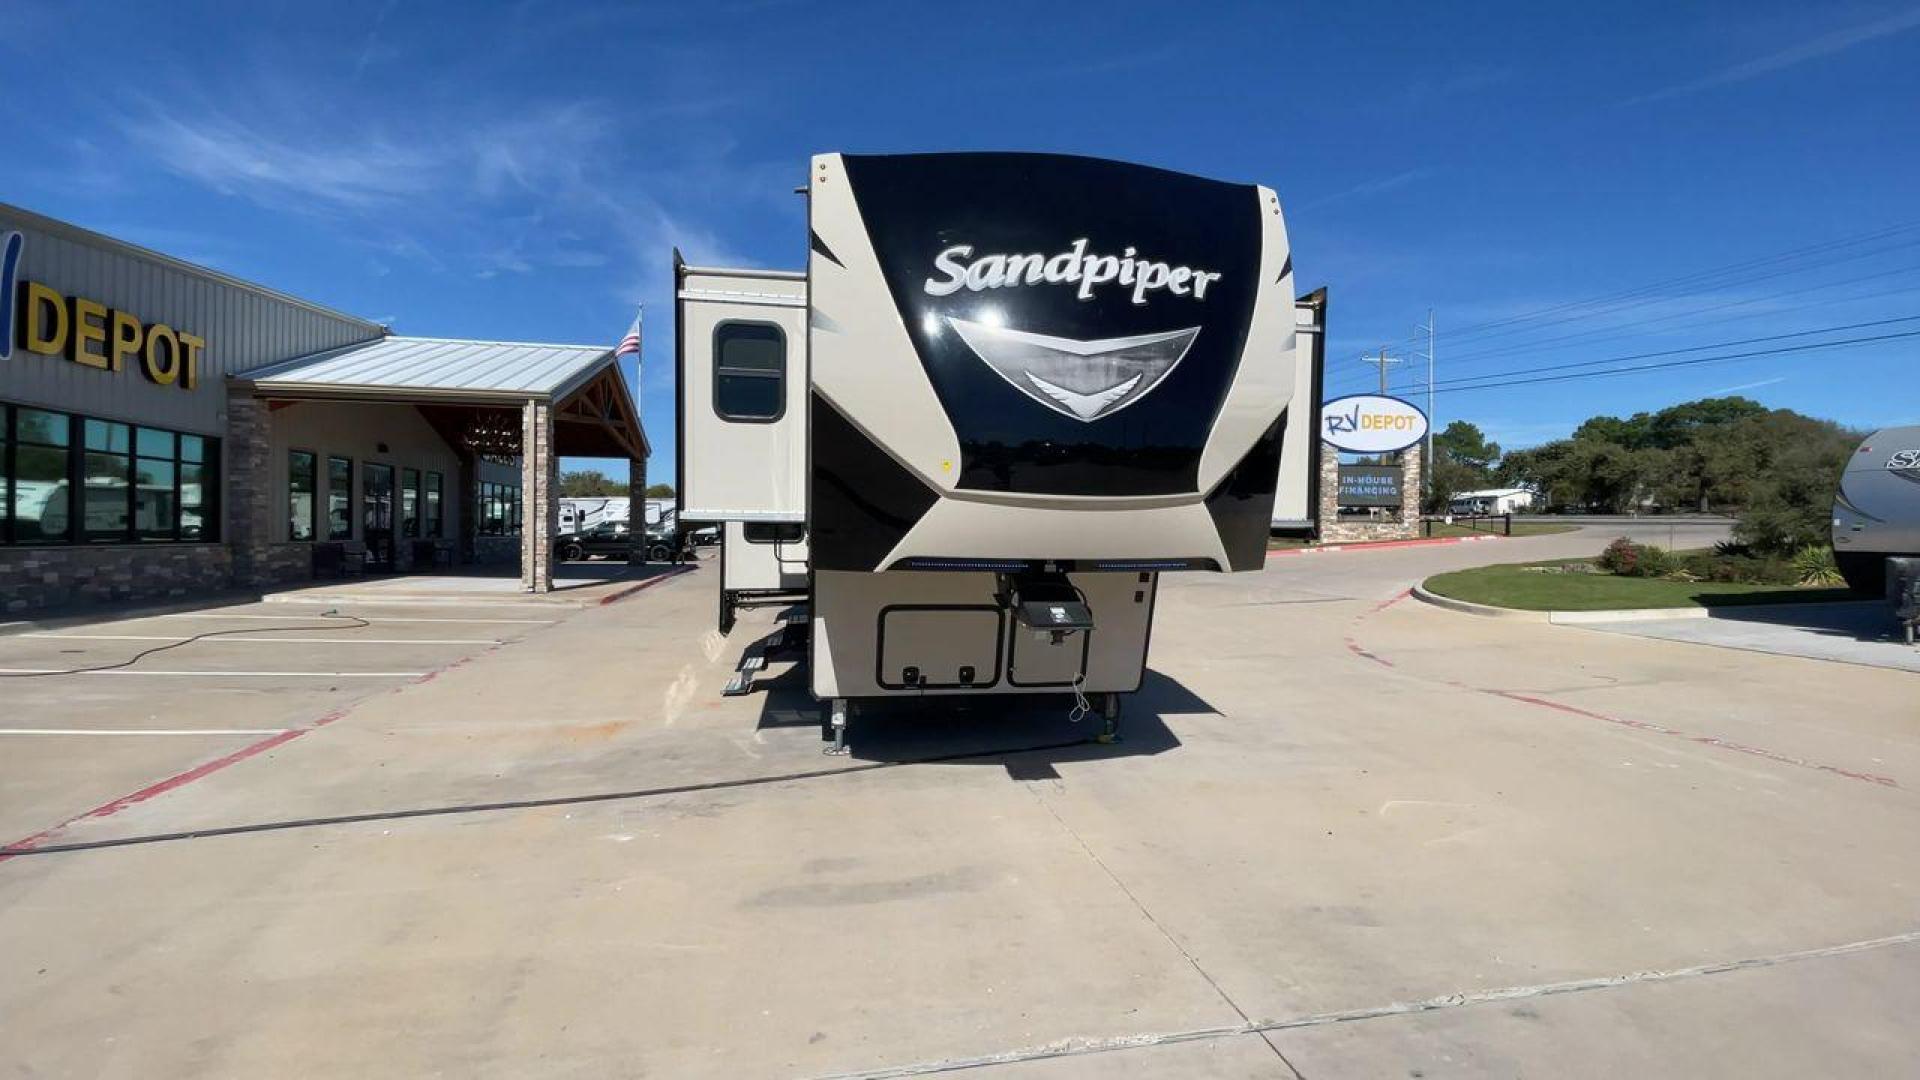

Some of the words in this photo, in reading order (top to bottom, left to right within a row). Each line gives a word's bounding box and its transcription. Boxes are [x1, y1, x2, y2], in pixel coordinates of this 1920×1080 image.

[923, 238, 1221, 304] Sandpiper
[19, 281, 205, 390] DEPOT
[1325, 403, 1359, 435] RV
[1361, 414, 1416, 432] DEPOT
[1339, 486, 1397, 496] FINANCING
[1343, 475, 1393, 484] IN-HOUSE
